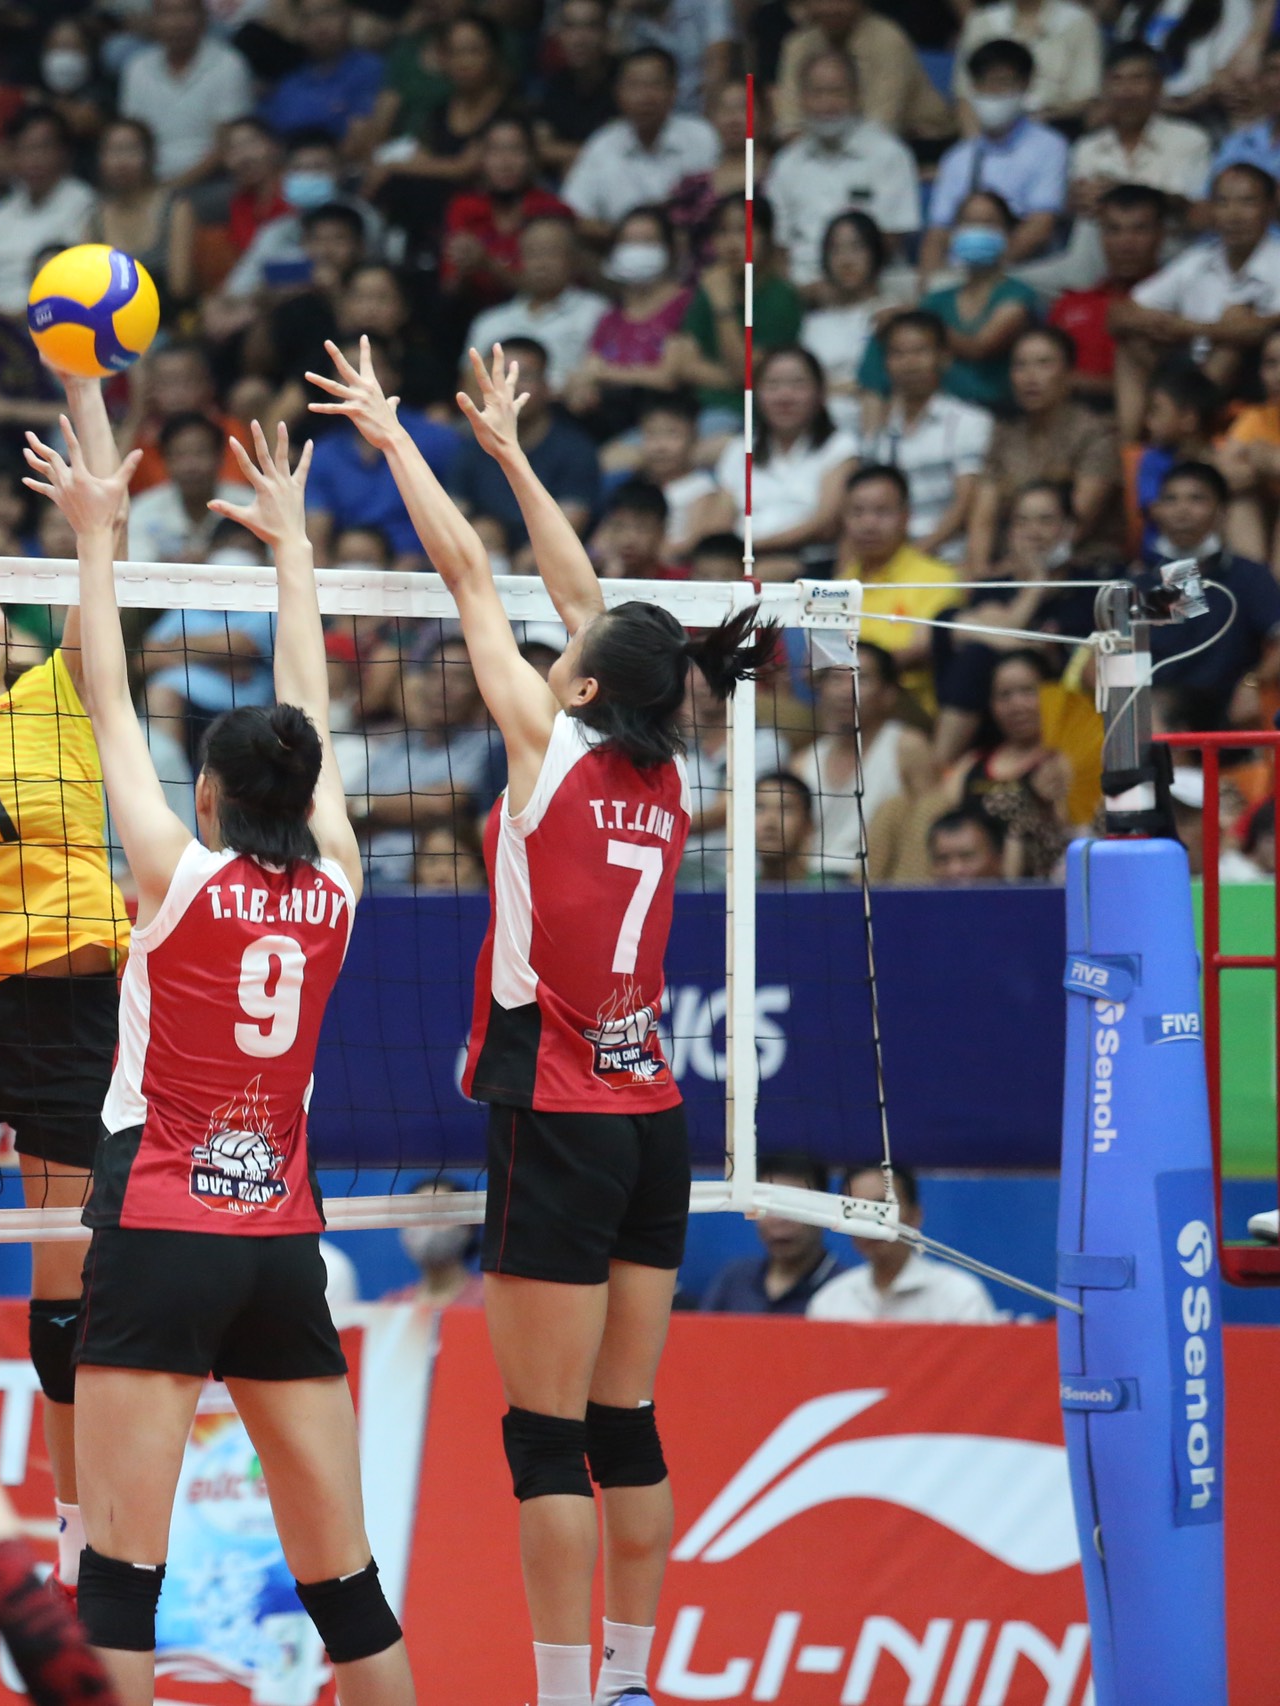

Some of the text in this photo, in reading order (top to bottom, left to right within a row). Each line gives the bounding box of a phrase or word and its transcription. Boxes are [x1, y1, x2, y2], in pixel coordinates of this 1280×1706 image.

[606, 838, 664, 975] 7
[234, 934, 308, 1059] 9
[1093, 1027, 1120, 1154] Senoh
[1062, 1382, 1113, 1403] Senoh
[1182, 1285, 1216, 1510] Senoh
[655, 1605, 1094, 1706] LI-NIN
